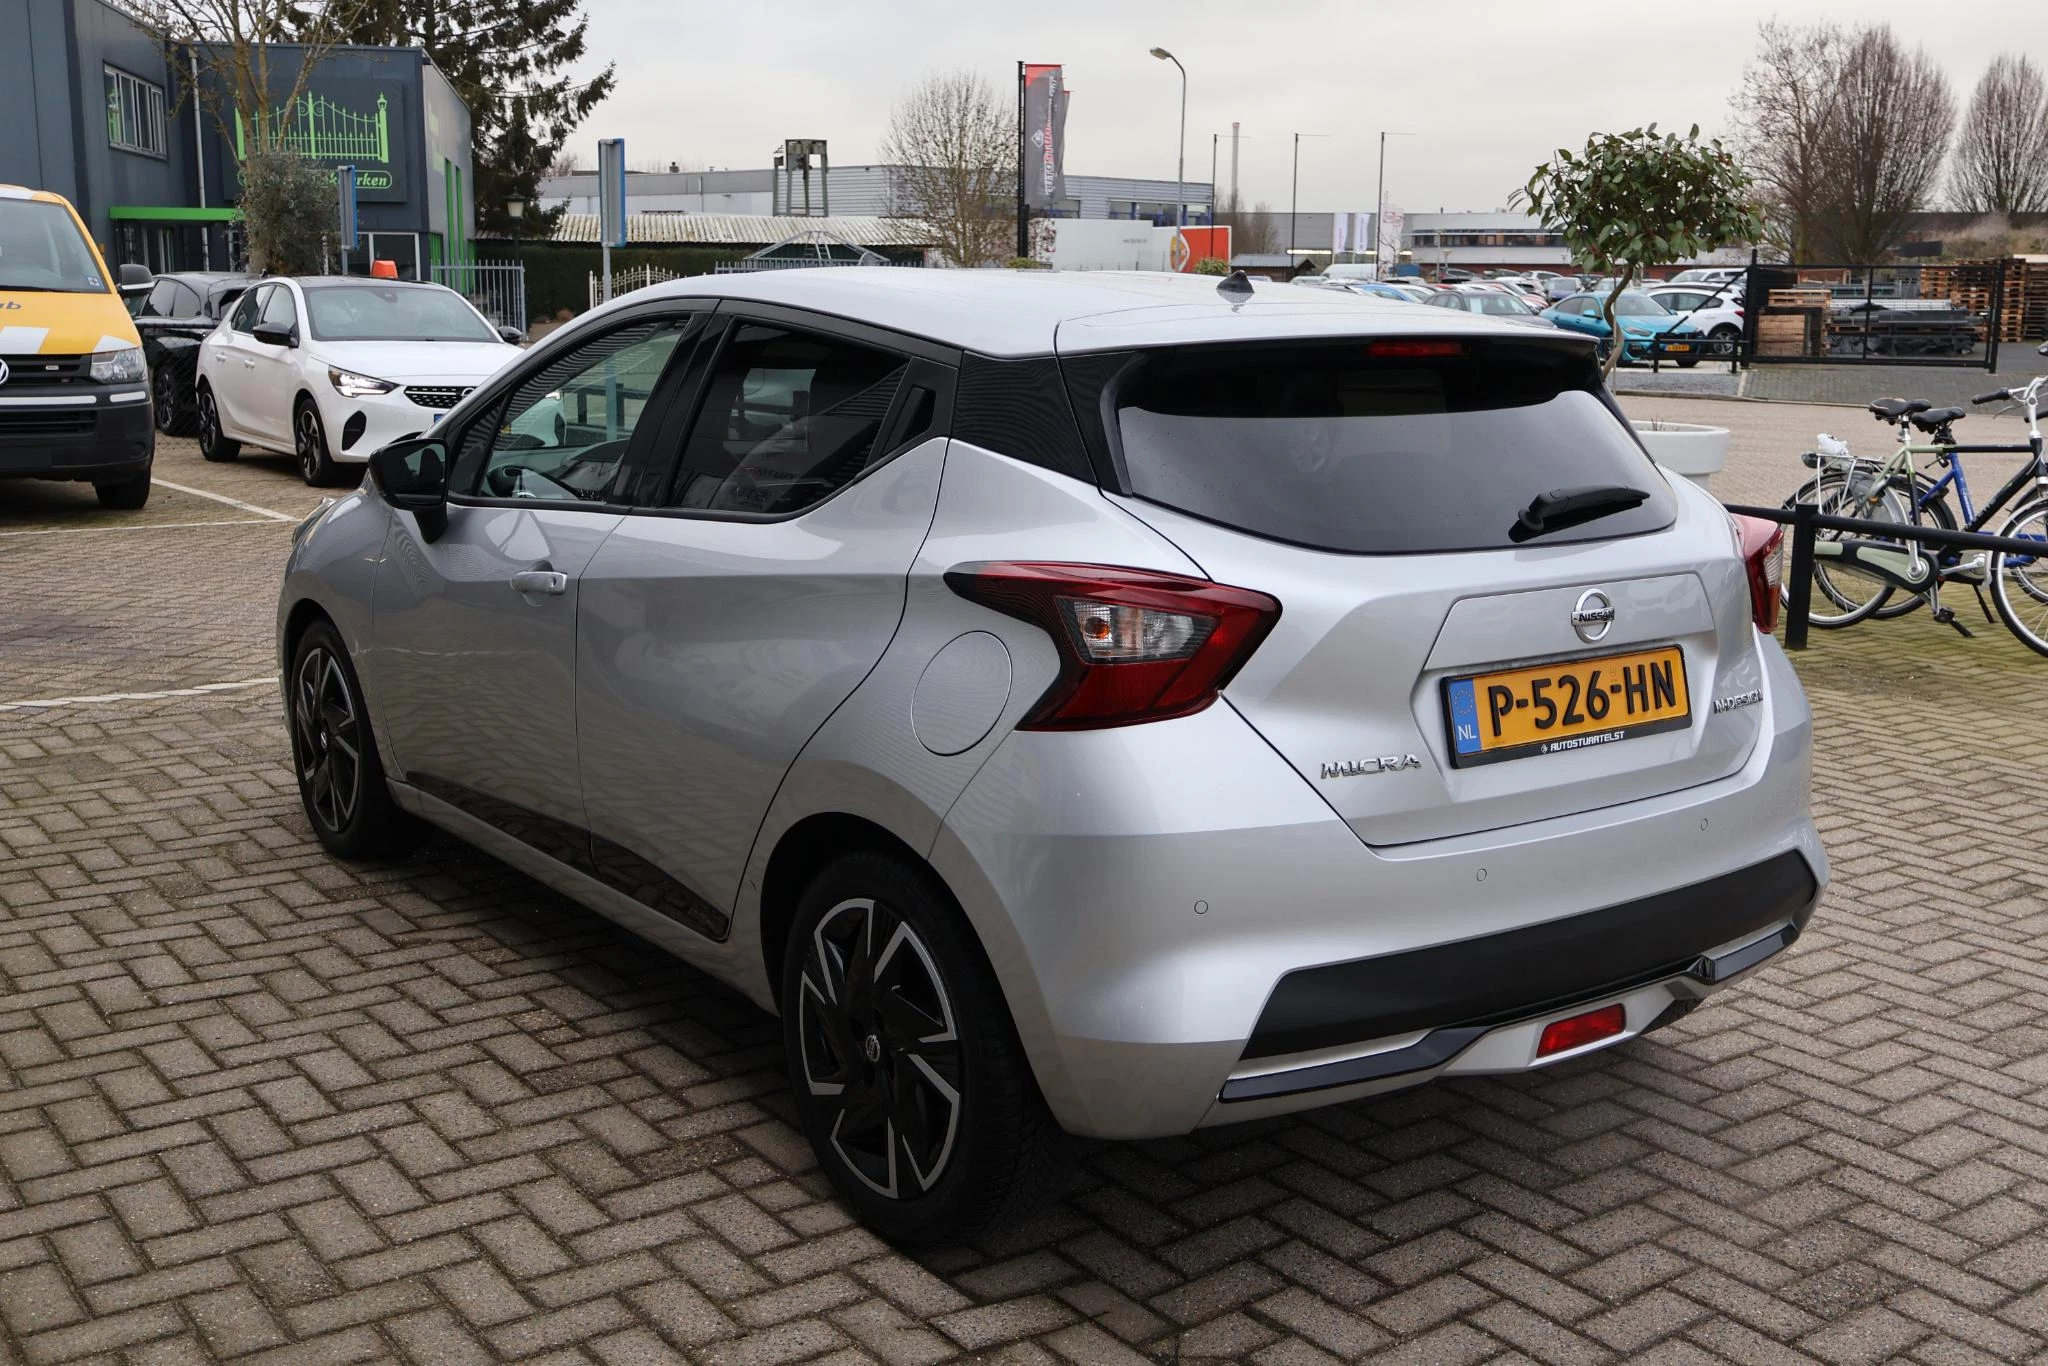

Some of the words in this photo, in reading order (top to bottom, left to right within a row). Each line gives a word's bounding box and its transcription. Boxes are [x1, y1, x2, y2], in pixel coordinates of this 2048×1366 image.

[1579, 609, 1614, 622] NISSAN
[1487, 659, 1677, 737] P-526-HN
[1457, 723, 1477, 741] NL
[1320, 753, 1422, 780] MICRA
